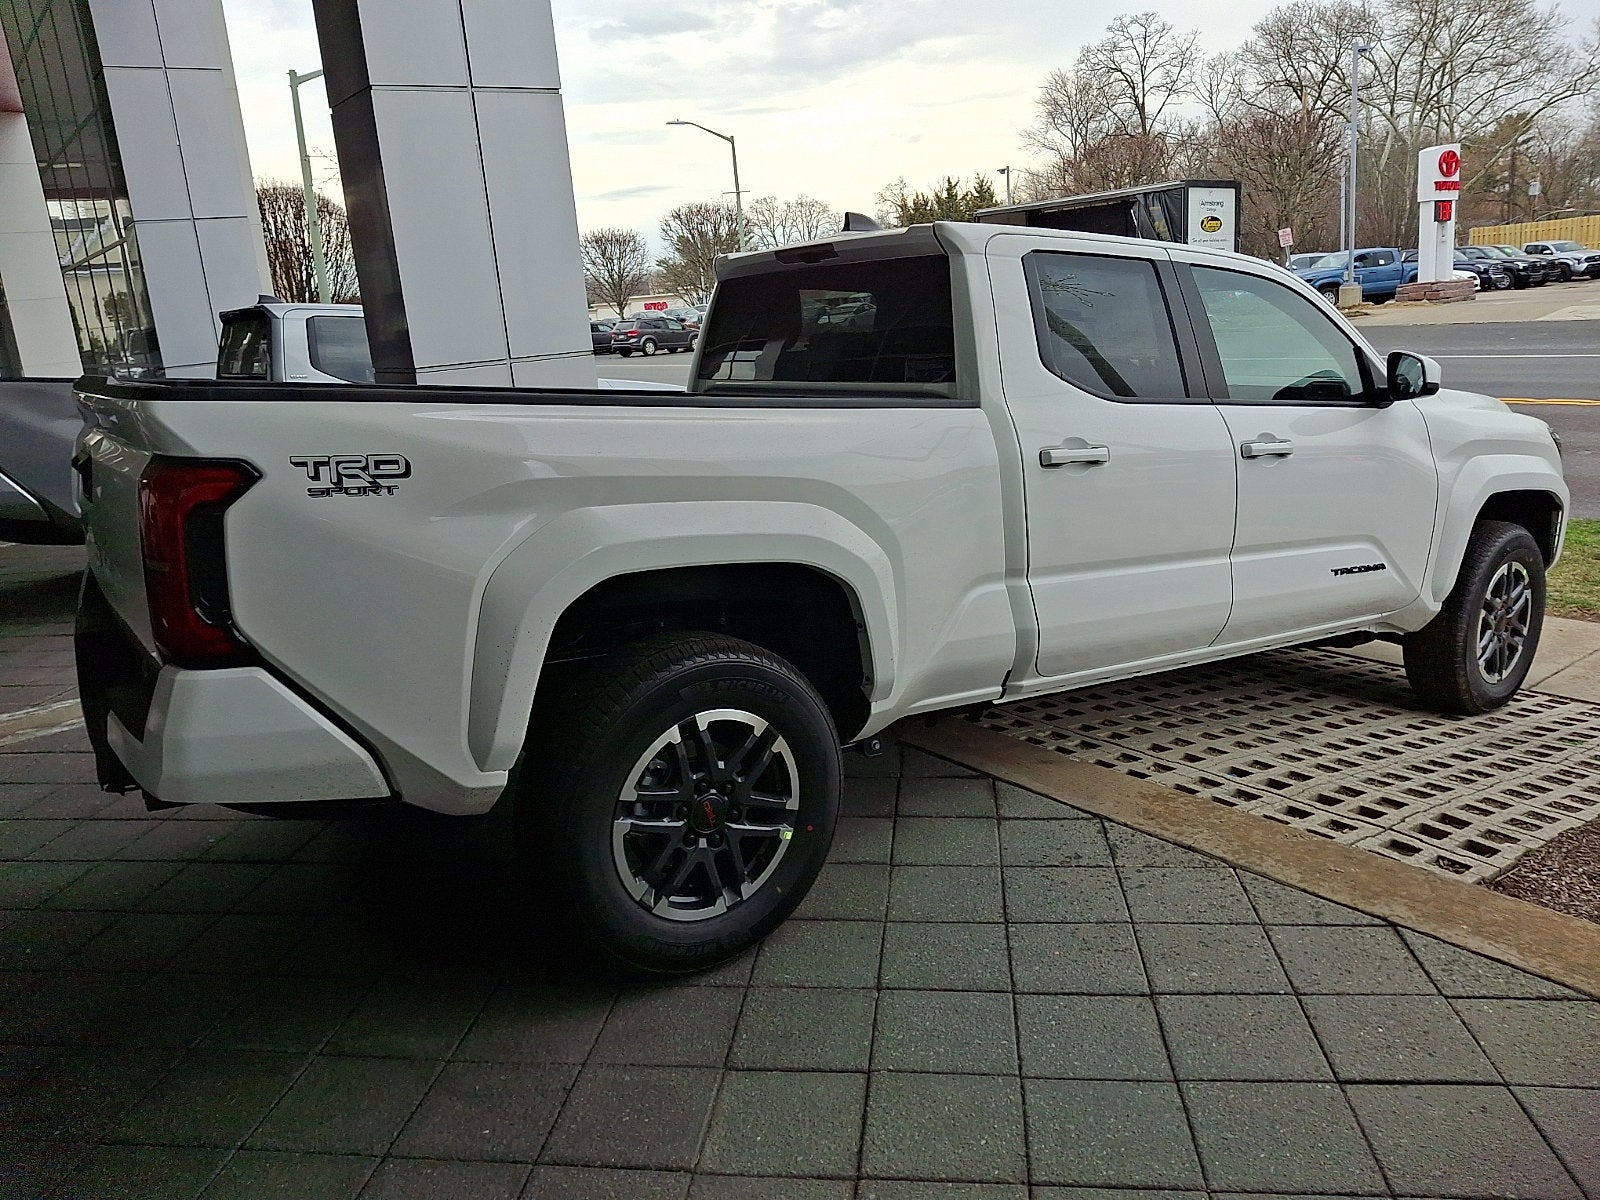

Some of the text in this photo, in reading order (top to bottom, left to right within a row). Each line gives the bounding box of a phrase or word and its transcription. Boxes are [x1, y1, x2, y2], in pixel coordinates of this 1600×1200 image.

[1200, 200, 1224, 208] Armstrong
[290, 453, 412, 487] TRD
[307, 485, 399, 498] SPORT
[1330, 563, 1386, 576] TACOMA
